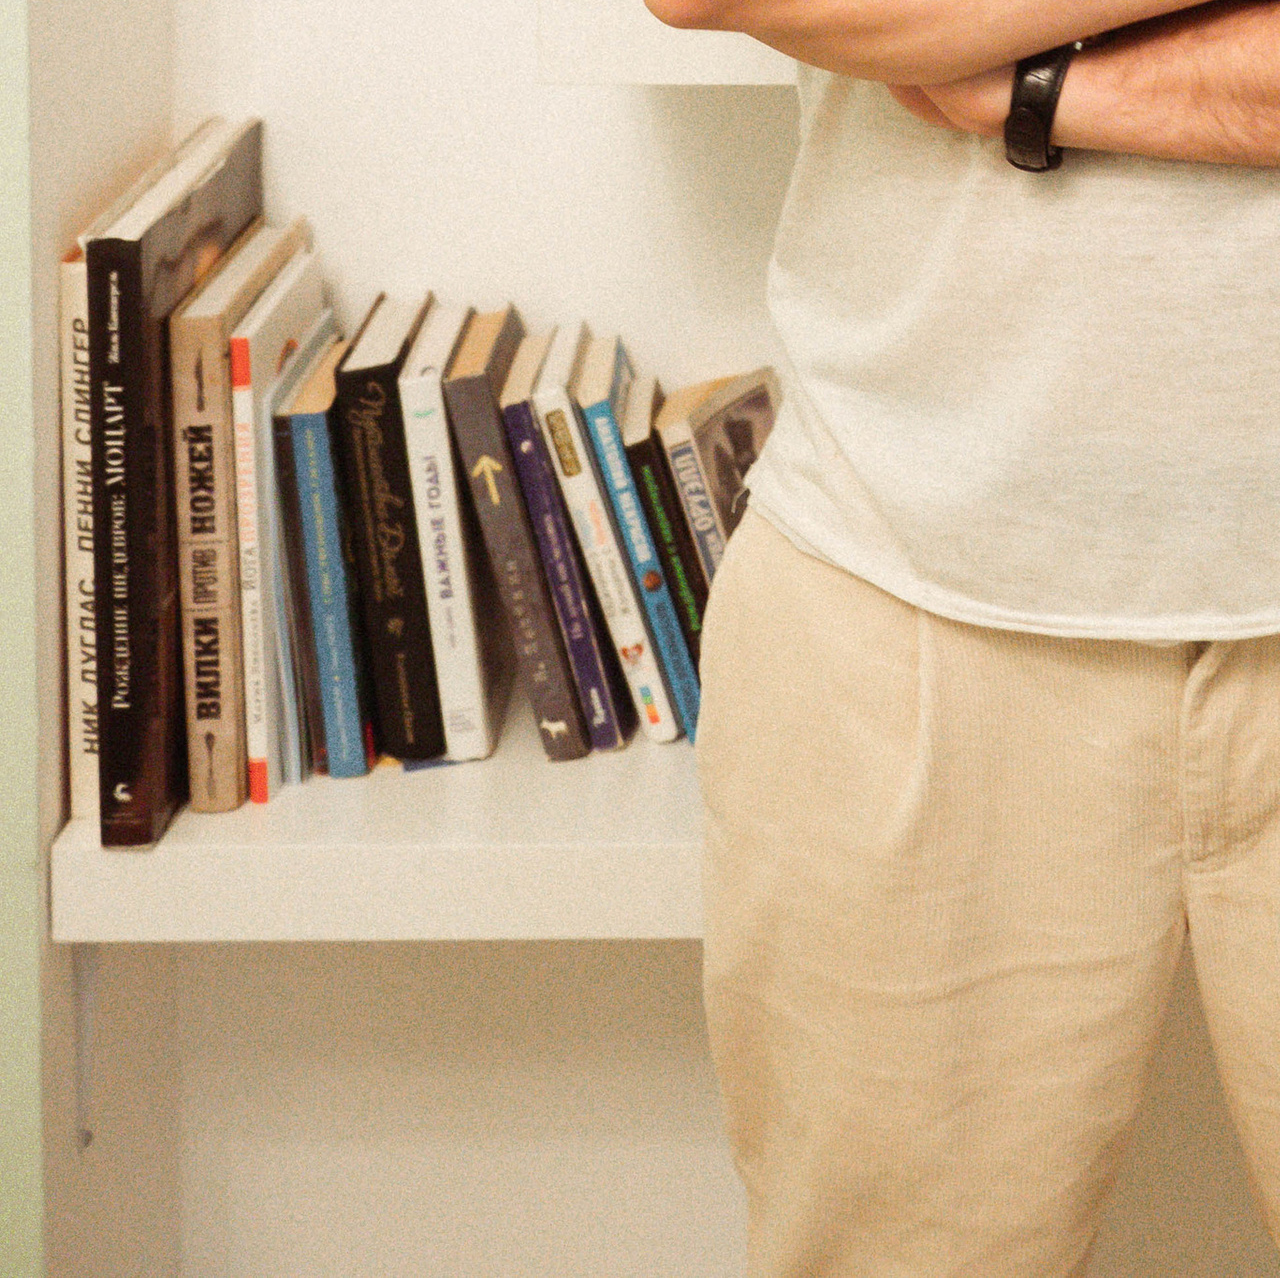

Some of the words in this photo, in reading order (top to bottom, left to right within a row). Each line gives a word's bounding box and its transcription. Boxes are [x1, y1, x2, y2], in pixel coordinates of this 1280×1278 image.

[70, 316, 92, 444] СЛИНГЕР
[102, 382, 126, 486] МОЦАРТ
[181, 424, 215, 534] НОЖЕЙ
[235, 423, 254, 541] ПРОЗРЕНИЯ
[423, 454, 441, 509] ГОДЫ
[74, 459, 95, 552] ПЕННИ
[191, 549, 217, 604] ПРОТИВ
[430, 517, 454, 600] ВАЖНЫЕ
[193, 616, 221, 720] ВИЛКИ
[81, 699, 99, 754] НИК
